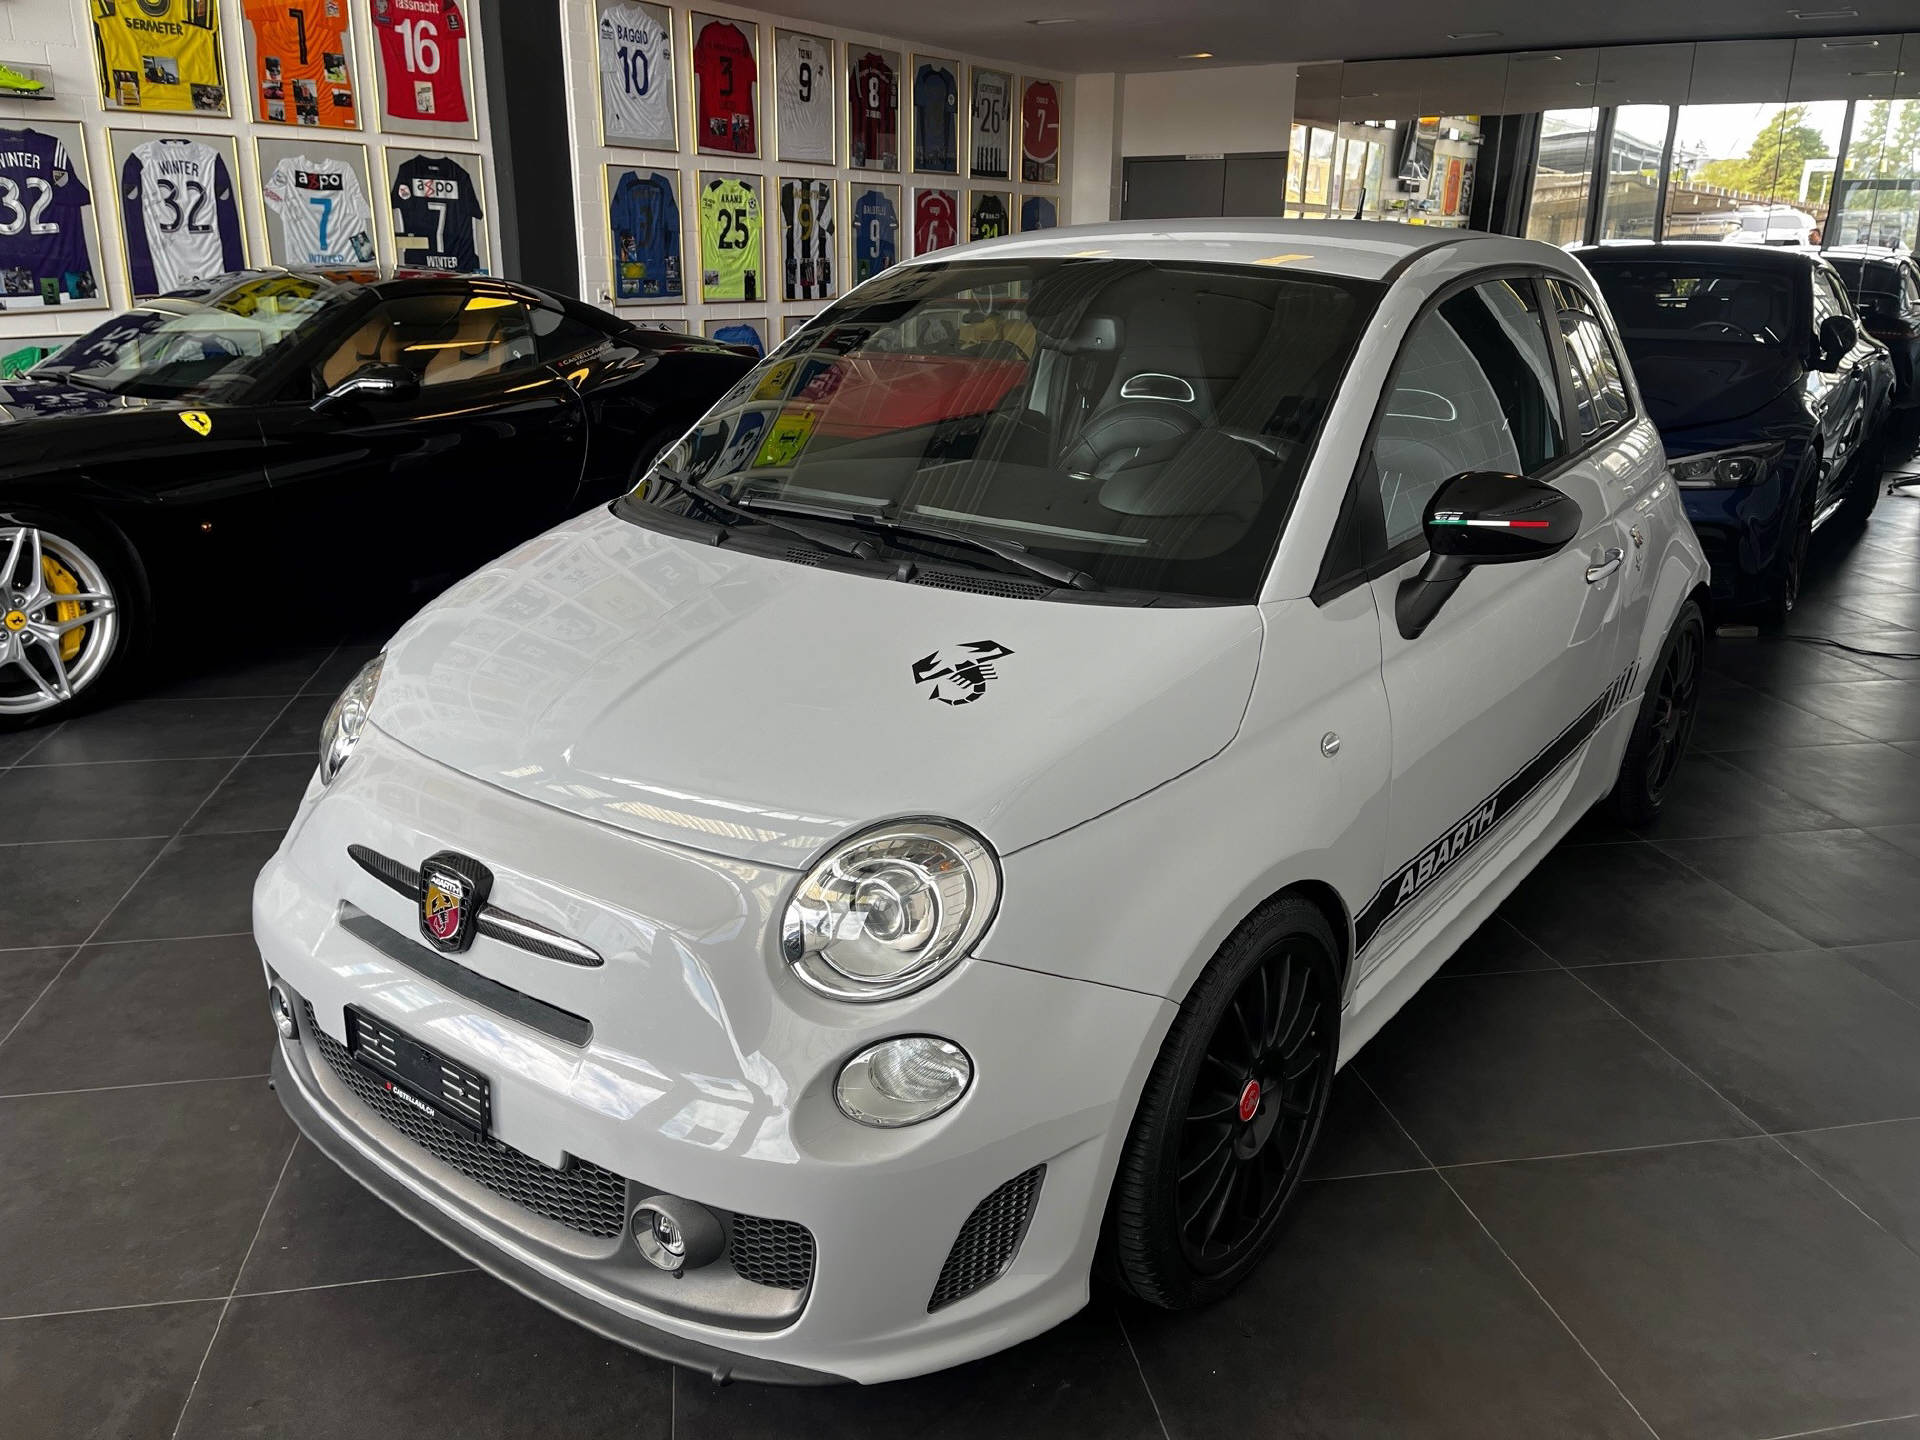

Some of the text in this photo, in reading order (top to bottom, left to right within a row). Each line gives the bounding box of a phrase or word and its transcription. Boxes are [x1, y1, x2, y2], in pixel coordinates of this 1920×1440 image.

[124, 16, 185, 36] SERMETER
[288, 8, 309, 65] 1
[616, 24, 649, 45] BAGGIO
[394, 18, 440, 75] 16
[617, 46, 649, 97] 10
[799, 63, 812, 103] 9
[868, 76, 880, 108] 8
[980, 98, 1000, 134] 26
[1036, 109, 1046, 142] 7
[159, 160, 200, 178] WINTER
[0, 176, 60, 236] 32
[157, 179, 214, 235] 32
[309, 197, 333, 251] 7
[797, 203, 814, 241] 9
[427, 202, 447, 253] 7
[717, 208, 749, 249] 25
[869, 219, 881, 258] 9
[426, 254, 459, 269] WINTER
[1394, 797, 1498, 907] ABARTH
[431, 875, 463, 896] ABARTH
